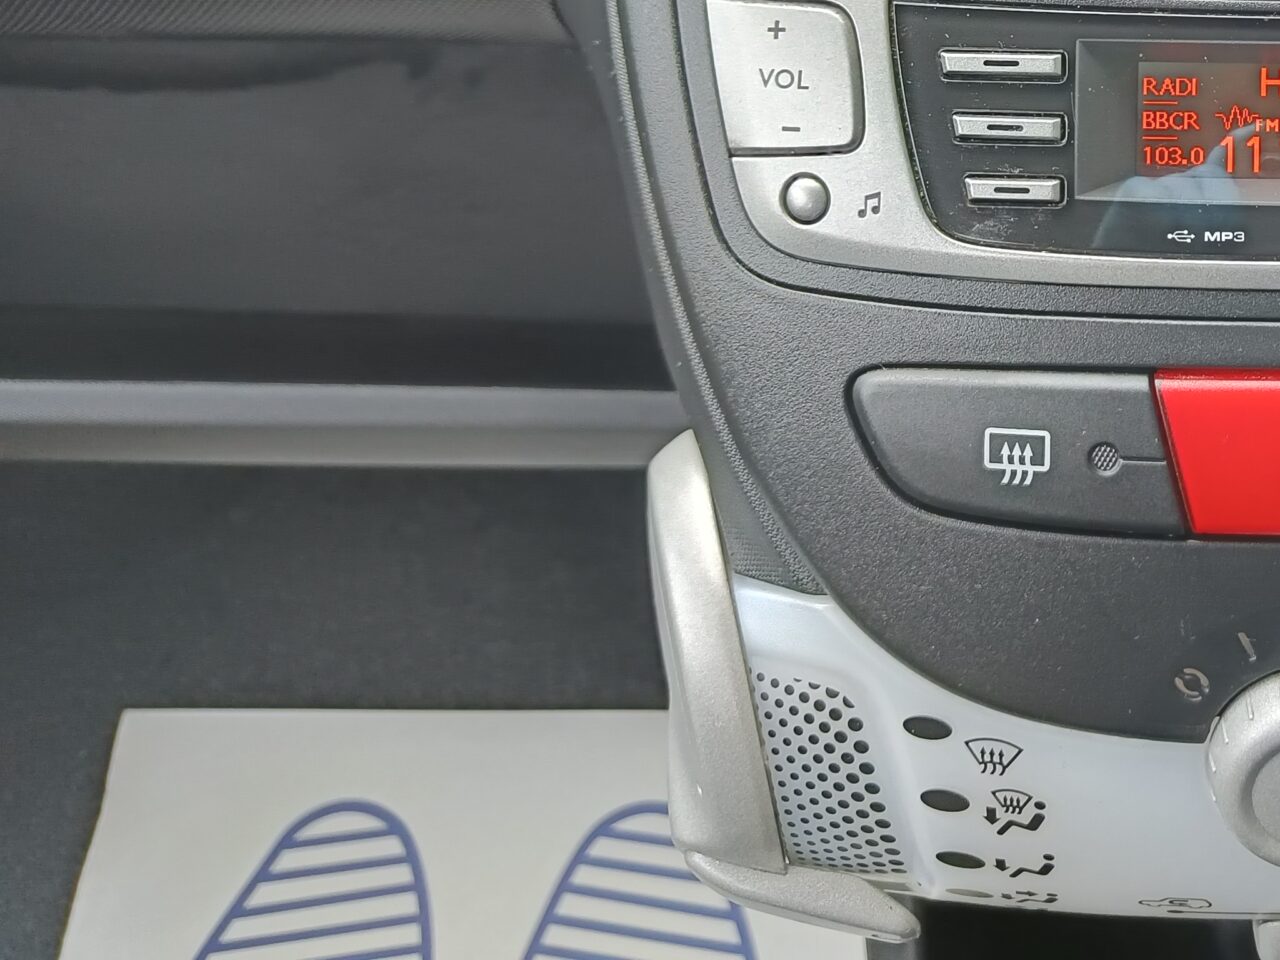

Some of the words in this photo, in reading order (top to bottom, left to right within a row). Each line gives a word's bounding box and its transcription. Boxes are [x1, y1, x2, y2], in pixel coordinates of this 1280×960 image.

[758, 68, 810, 91] VOL
[1142, 77, 1198, 98] RADI
[1141, 111, 1200, 132] BBCR
[1143, 145, 1204, 167] 103.0
[1204, 231, 1245, 243] MP3
